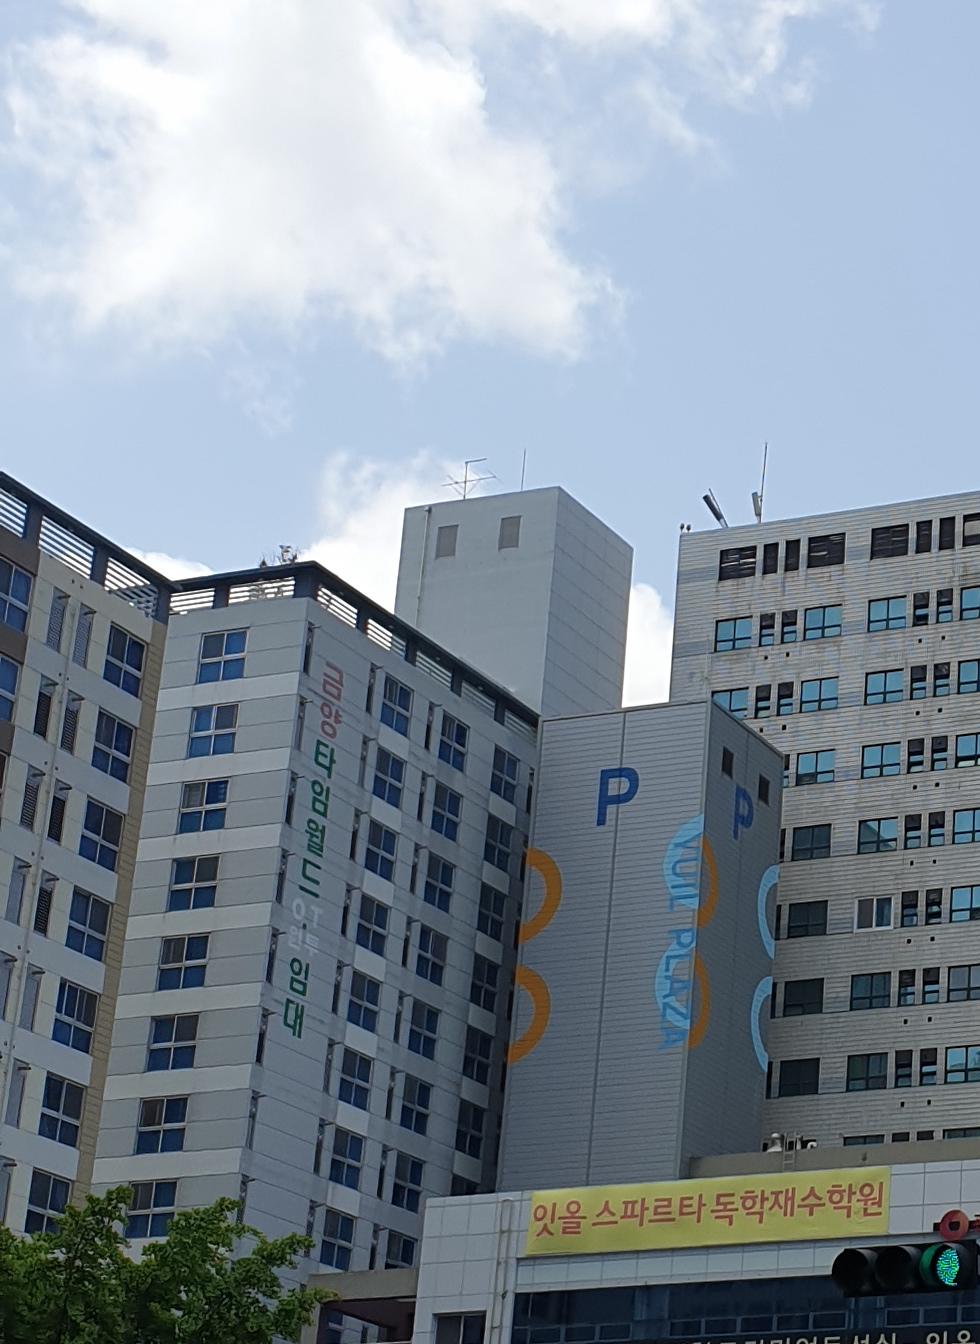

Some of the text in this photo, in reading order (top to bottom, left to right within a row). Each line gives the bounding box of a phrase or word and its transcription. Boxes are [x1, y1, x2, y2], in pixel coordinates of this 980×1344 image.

[596, 767, 640, 826] P
[283, 956, 310, 1040] 임대
[657, 927, 697, 1053] PLAZA
[532, 1180, 886, 1238] 잇올 스파르타 독학재수학원
